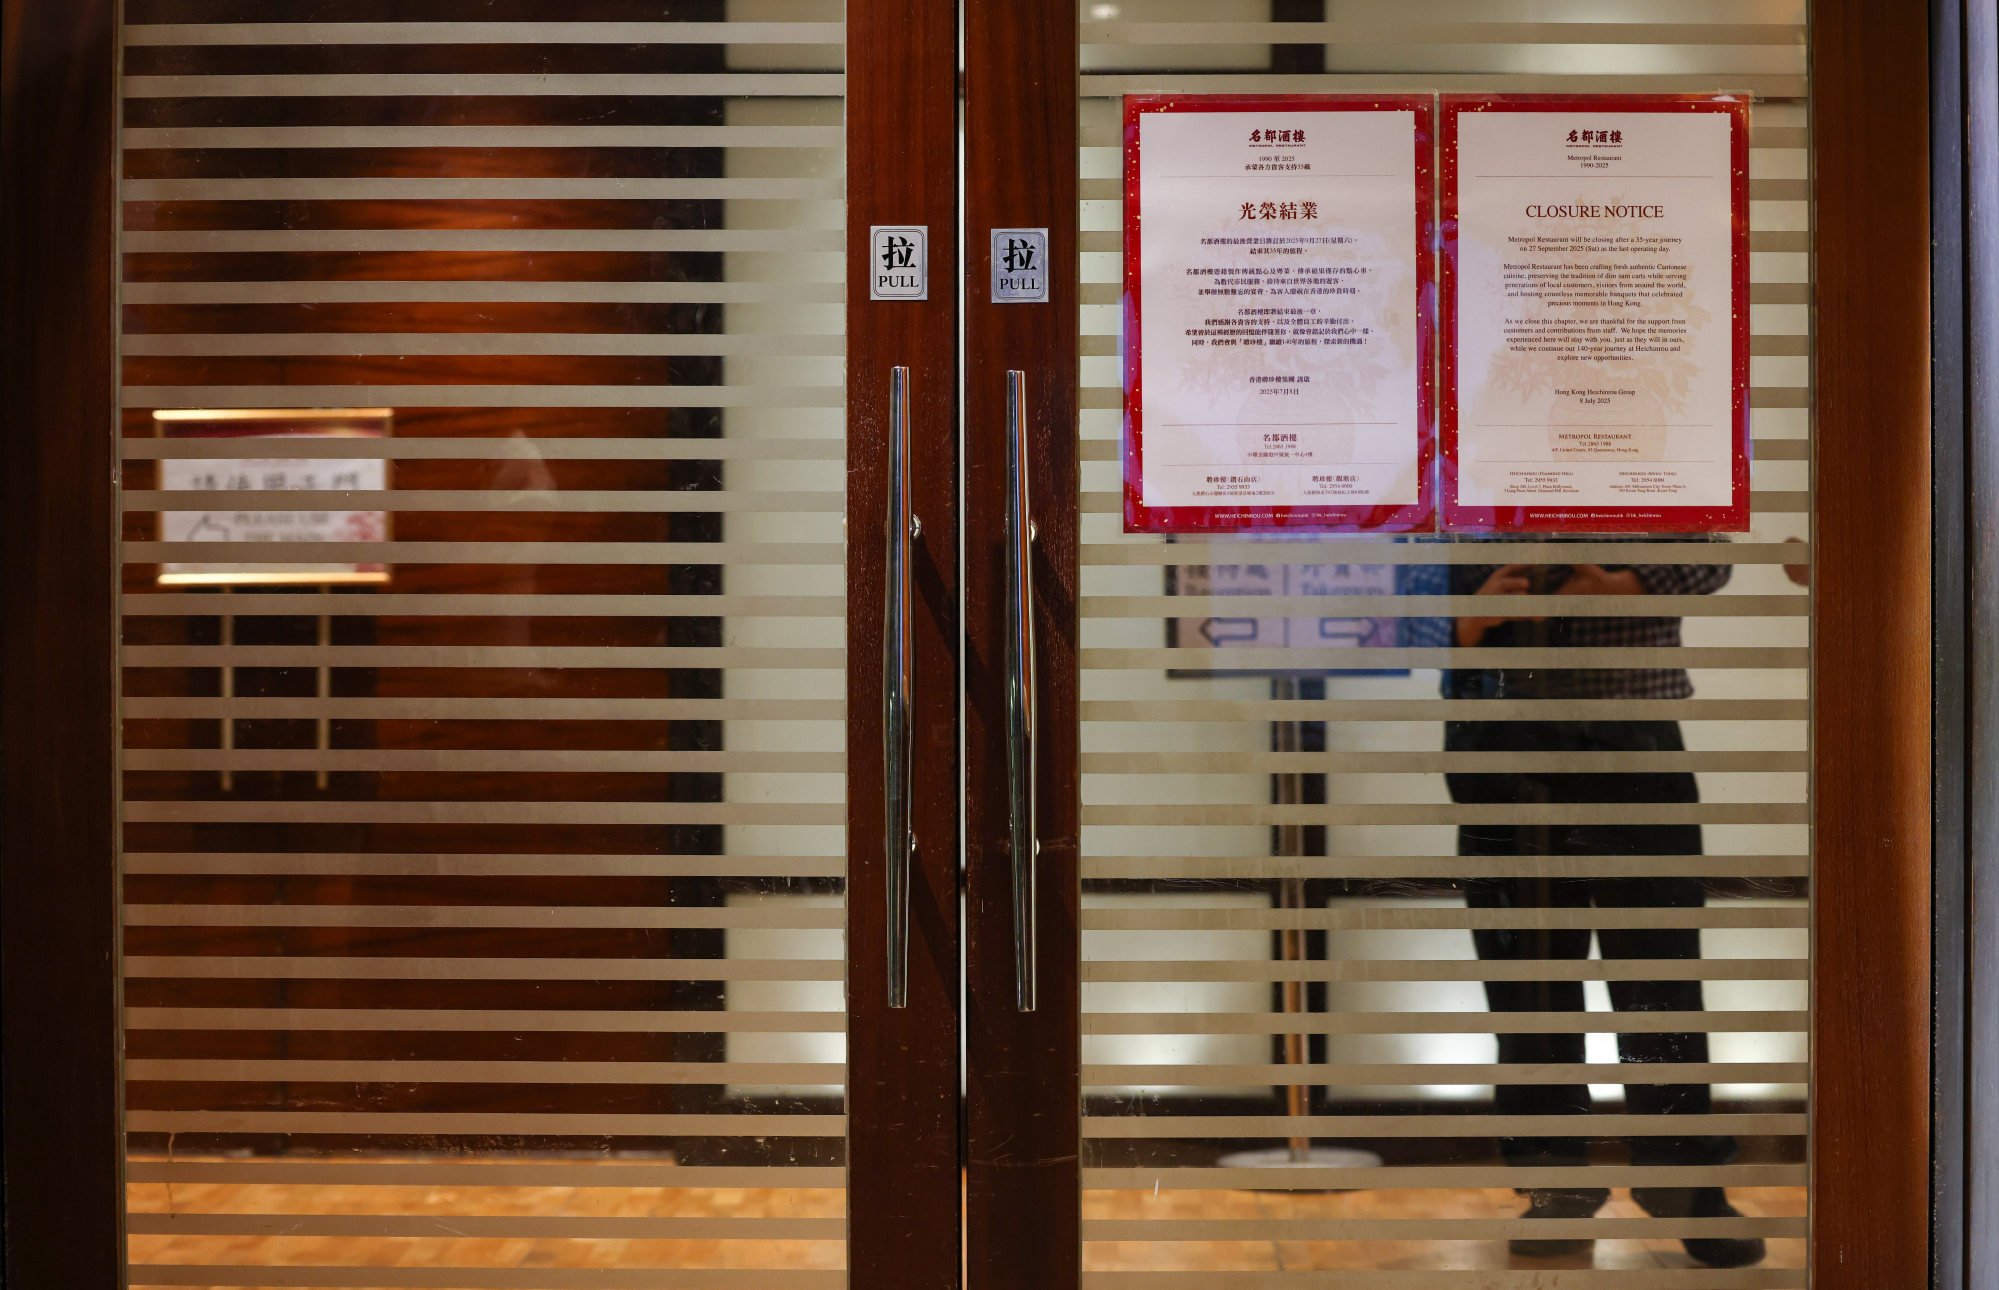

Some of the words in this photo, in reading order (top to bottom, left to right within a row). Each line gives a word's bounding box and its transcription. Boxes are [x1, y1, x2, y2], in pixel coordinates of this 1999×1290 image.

[1249, 128, 1306, 143] 名都酒樓
[1566, 131, 1623, 143] 名都酒樓
[1238, 202, 1318, 220] 光榮結業
[1526, 205, 1600, 218] CLOSURE
[1605, 205, 1664, 218] NOTICE
[1508, 236, 1536, 245] Metropol
[1592, 236, 1614, 245] closing
[1636, 236, 1658, 245] 35-year
[1659, 236, 1682, 245] journey
[881, 236, 916, 271] 拉
[1002, 238, 1037, 273] 拉
[1504, 264, 1531, 272] Metropol
[1589, 264, 1612, 272] crafting
[878, 275, 920, 288] PULL
[1504, 273, 1526, 281] cuisine,
[1527, 273, 1559, 281] preserving
[1665, 273, 1686, 281] serving
[1000, 278, 1040, 290] PULL
[1504, 282, 1539, 290] generations
[1563, 282, 1595, 290] customers,
[1667, 282, 1685, 290] world,
[1520, 291, 1543, 299] hosting
[1609, 291, 1637, 299] banquets
[1554, 318, 1578, 326] chapter,
[1647, 318, 1670, 326] support
[1557, 355, 1579, 363] explore
[1593, 355, 1633, 363] opportunities.
[1264, 433, 1297, 442] 名都酒樓
